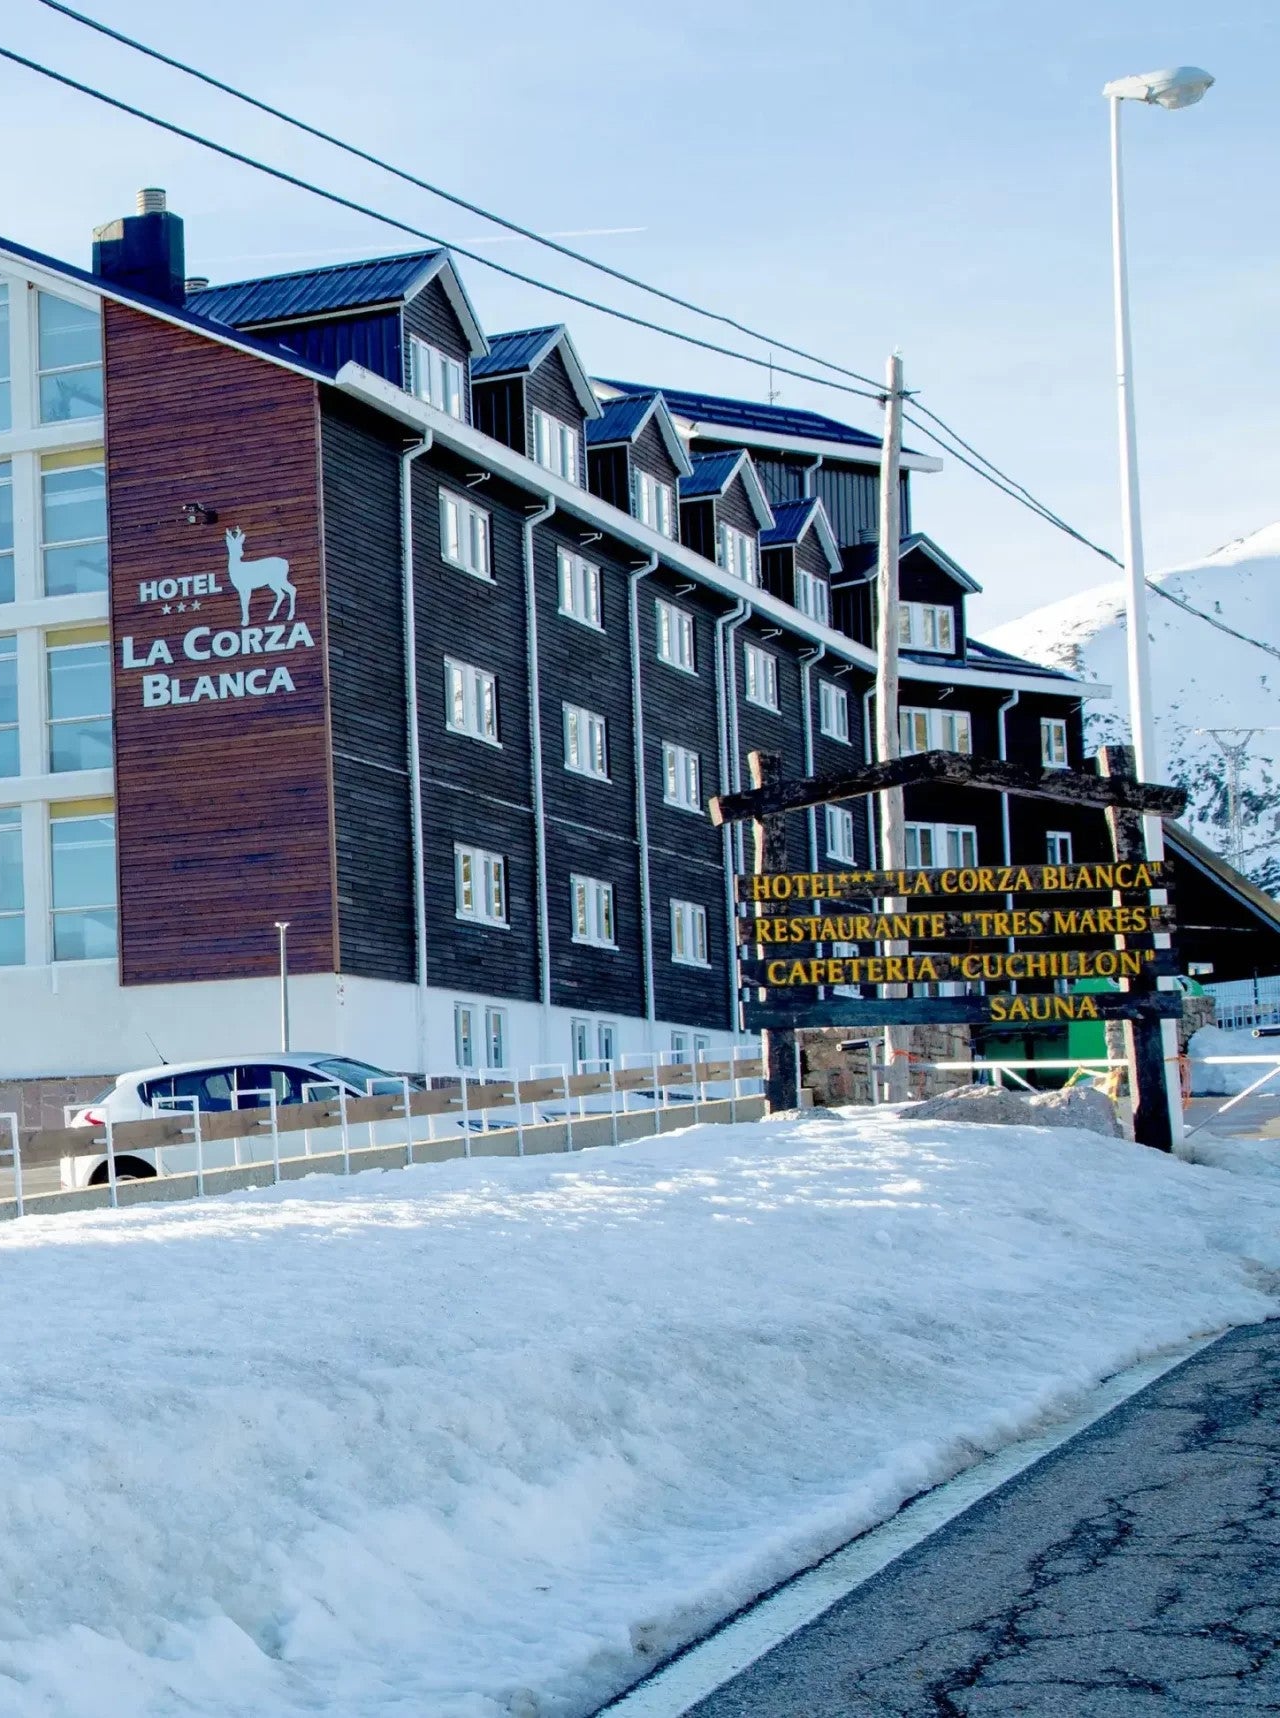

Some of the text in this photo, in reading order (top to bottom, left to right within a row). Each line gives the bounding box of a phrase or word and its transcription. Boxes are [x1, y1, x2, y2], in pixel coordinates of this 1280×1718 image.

[139, 573, 222, 602] HOTEL
[122, 622, 315, 669] LA CORZA
[143, 666, 296, 708] BLANCA
[886, 869, 933, 895] "LA
[940, 866, 1033, 893] CORZA
[1042, 862, 1162, 890] BLANCA"
[755, 906, 1160, 942] RESTAURANTE "TRES MARES"
[767, 949, 1155, 985] CAFETERIA "CUCHILLON"
[990, 995, 1098, 1022] SAUNA
